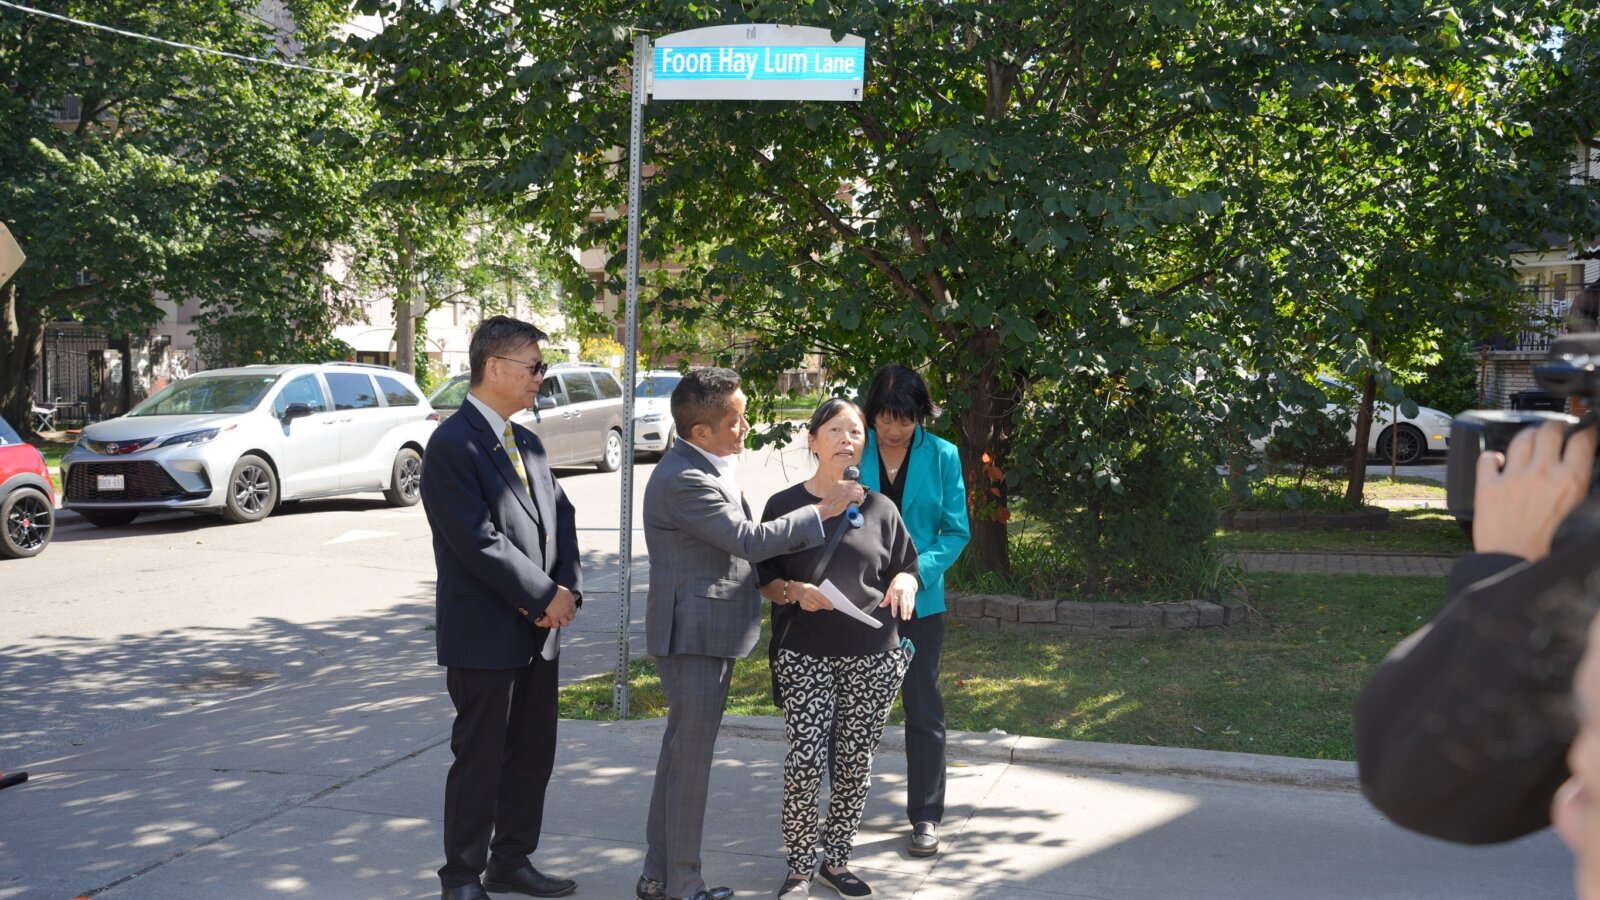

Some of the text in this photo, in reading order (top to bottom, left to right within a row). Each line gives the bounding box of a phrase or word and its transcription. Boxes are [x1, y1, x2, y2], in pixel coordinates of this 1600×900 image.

[662, 47, 855, 80] Foon Hay Lum Lane
